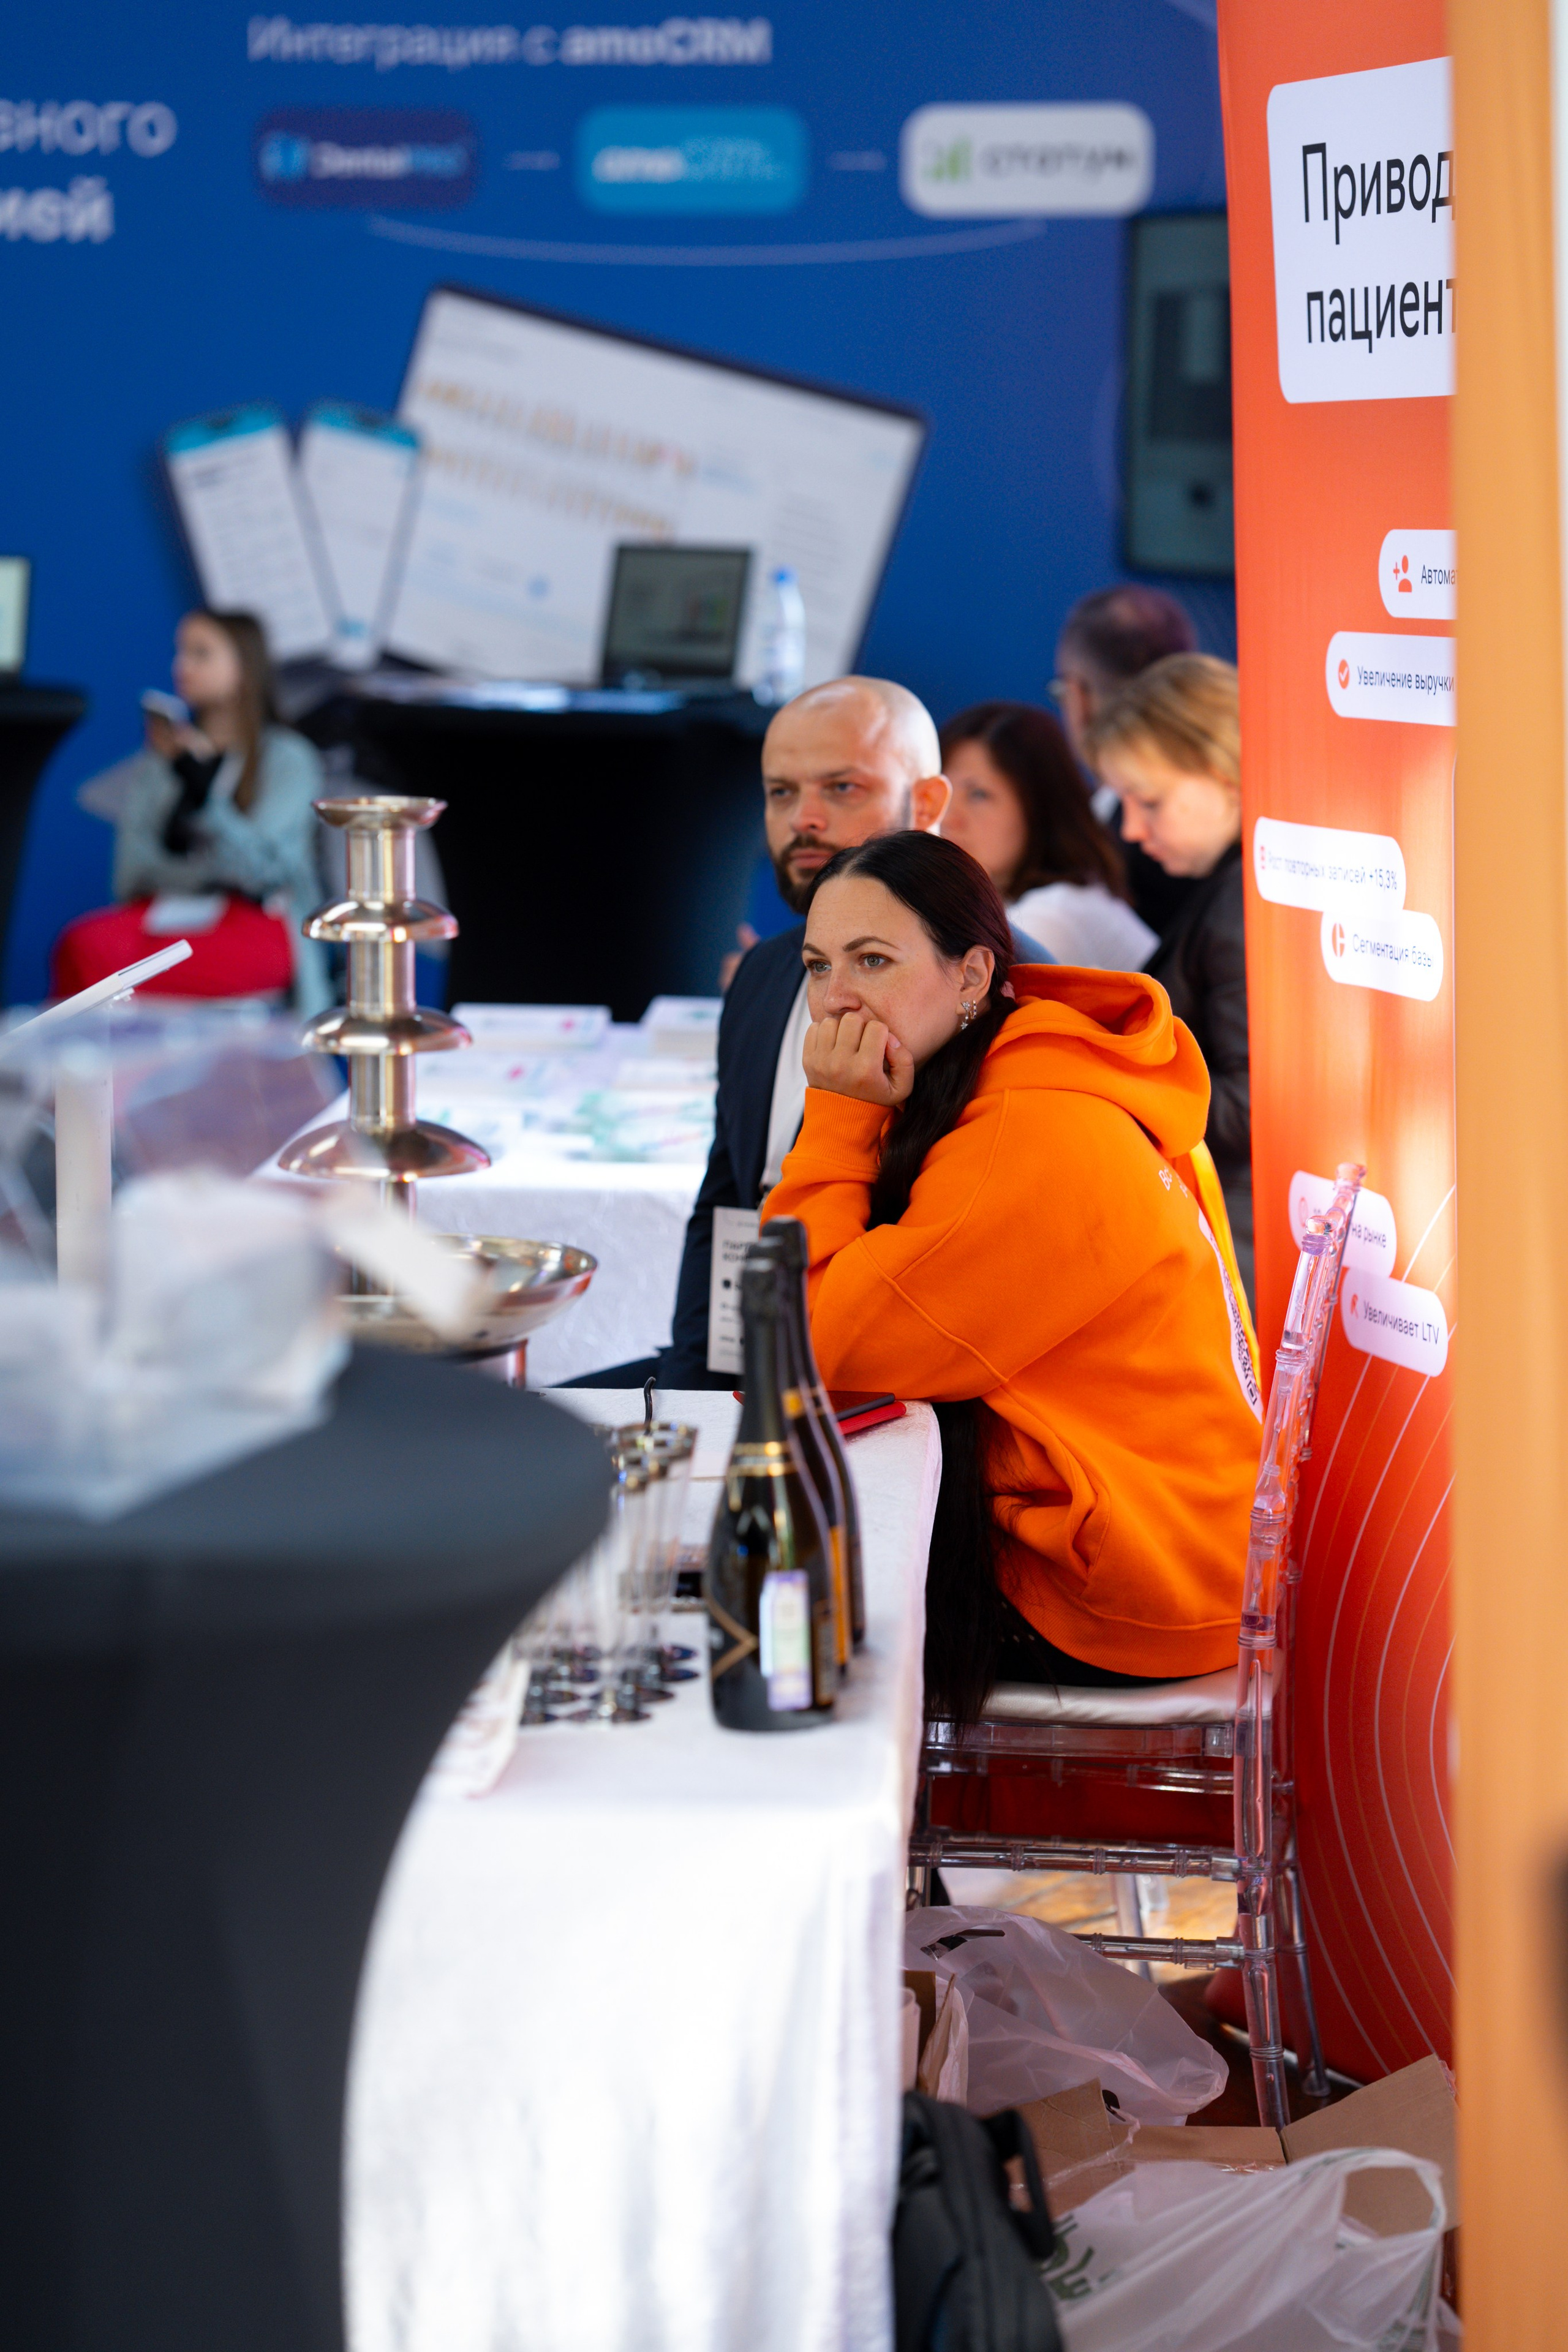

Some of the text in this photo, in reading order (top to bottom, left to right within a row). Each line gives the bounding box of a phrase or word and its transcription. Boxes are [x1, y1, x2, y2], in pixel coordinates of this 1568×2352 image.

[247, 16, 519, 72] Интеграция
[560, 16, 771, 66] amoCRM
[1302, 142, 1455, 245] Привод
[1420, 564, 1457, 585] Автома
[1357, 665, 1455, 696] Увеличение выручки
[1328, 866, 1366, 884] записей
[1368, 868, 1398, 891] +15,3%
[1352, 934, 1434, 967] Сегментация базы
[1363, 1226, 1387, 1248] рынке
[1363, 1300, 1440, 1345] Увеличивает LTV
